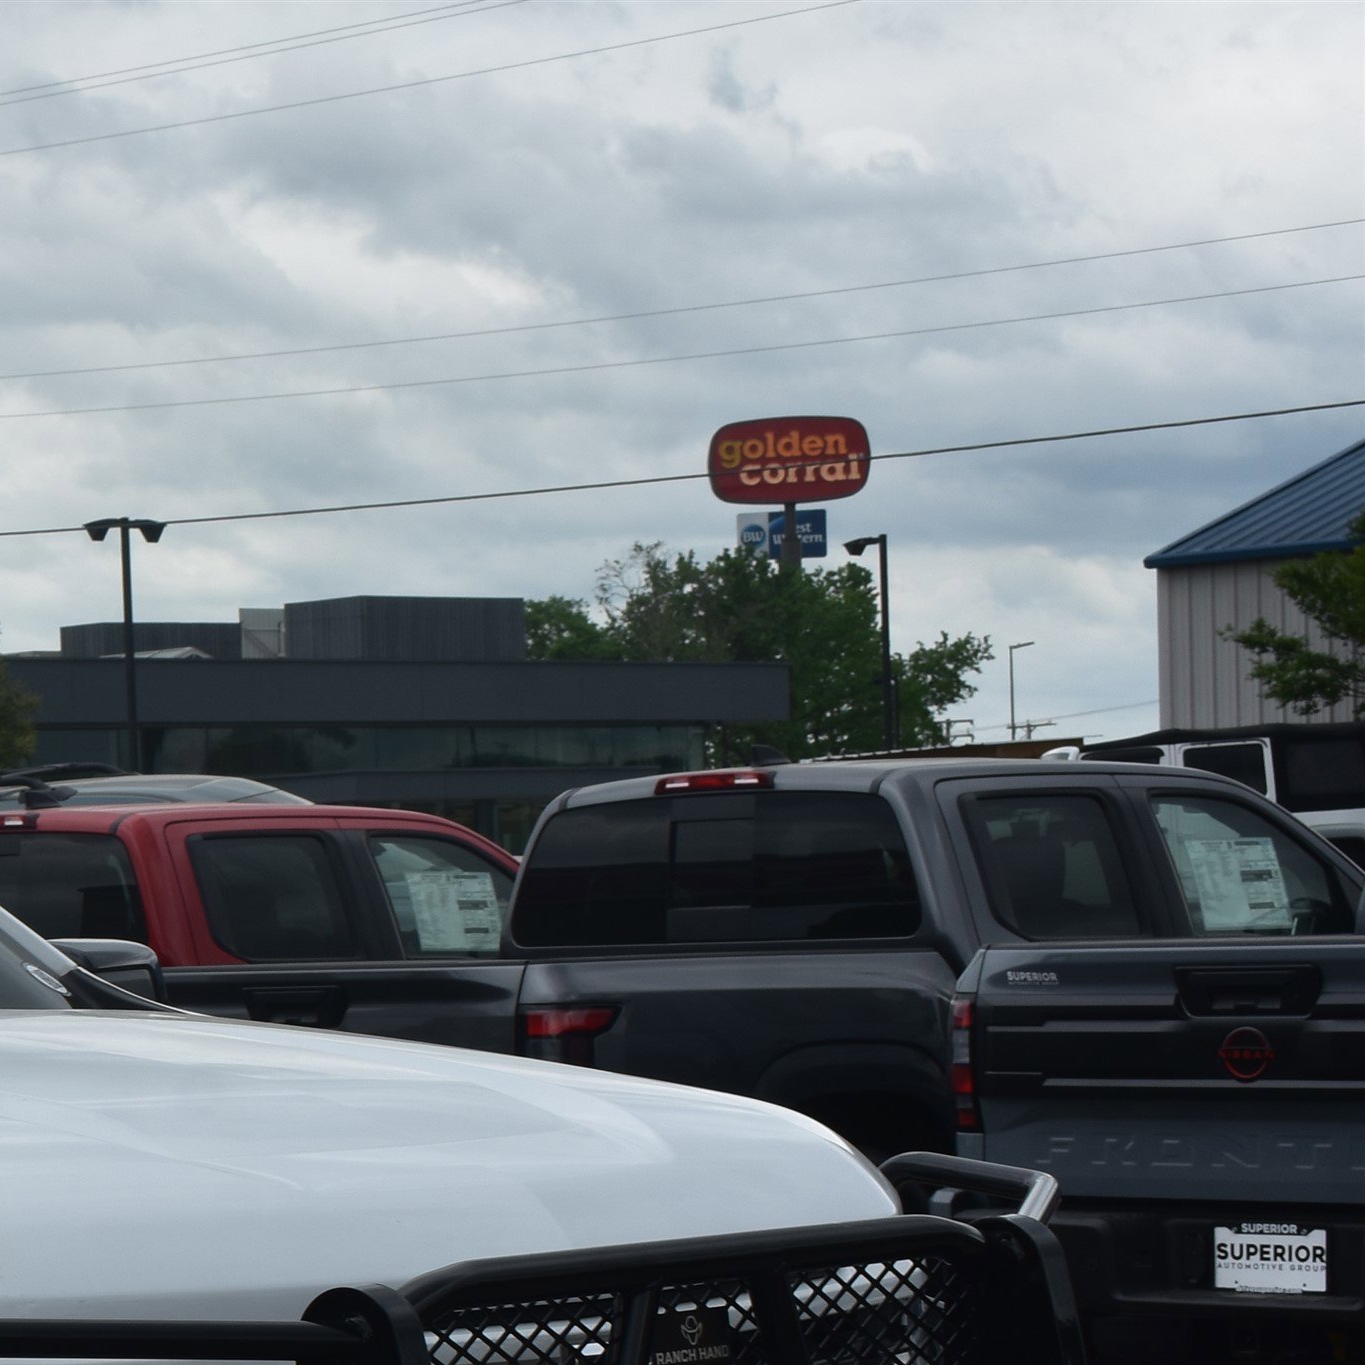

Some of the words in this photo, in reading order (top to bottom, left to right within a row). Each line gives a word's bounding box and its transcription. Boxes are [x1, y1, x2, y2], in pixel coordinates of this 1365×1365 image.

[719, 430, 847, 468] golden
[739, 453, 860, 486] corral
[1007, 971, 1058, 981] SUPERIOR
[1241, 1223, 1297, 1234] SUPERIOR
[1216, 1243, 1326, 1262] SUPERIOR
[1217, 1263, 1283, 1271] AUTOMOTIVE
[1290, 1264, 1326, 1272] GROUP
[655, 1349, 697, 1365] RANCH
[698, 1345, 729, 1360] HAND
